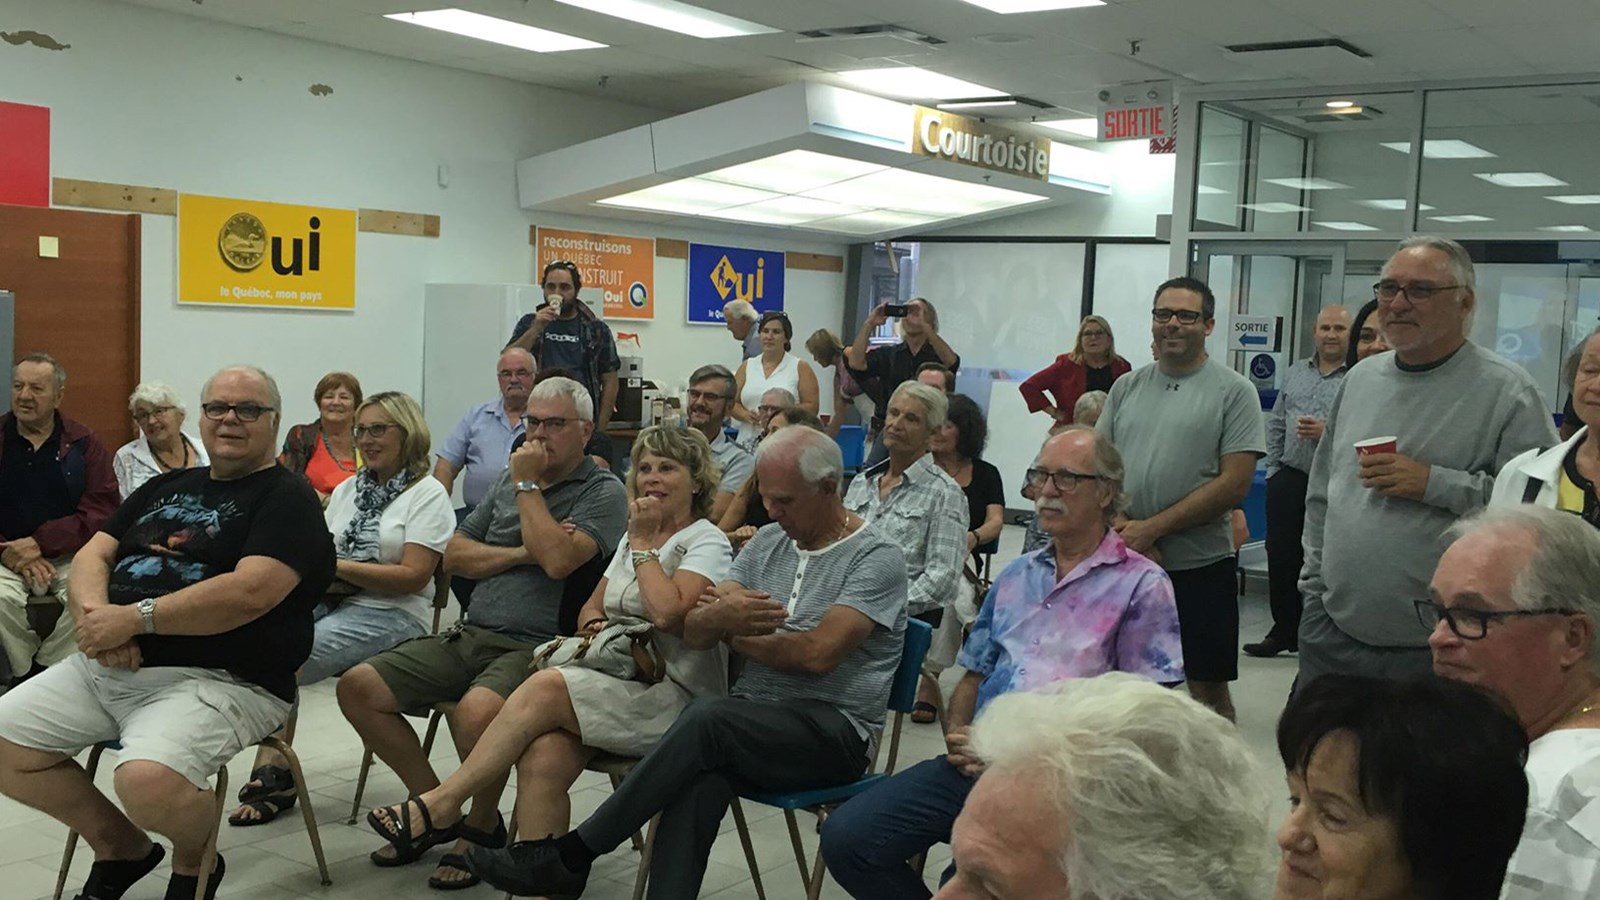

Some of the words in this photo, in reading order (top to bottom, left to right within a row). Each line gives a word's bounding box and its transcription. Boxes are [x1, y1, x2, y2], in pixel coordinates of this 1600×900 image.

[1104, 106, 1166, 140] SORTIE
[920, 115, 1048, 176] Courtoisie
[543, 236, 632, 254] reconstruisons
[543, 250, 559, 261] UN
[220, 286, 230, 296] le
[275, 289, 297, 299] mon
[300, 291, 323, 302] pays
[604, 290, 624, 303] Oui
[1234, 322, 1269, 333] SORTIE
